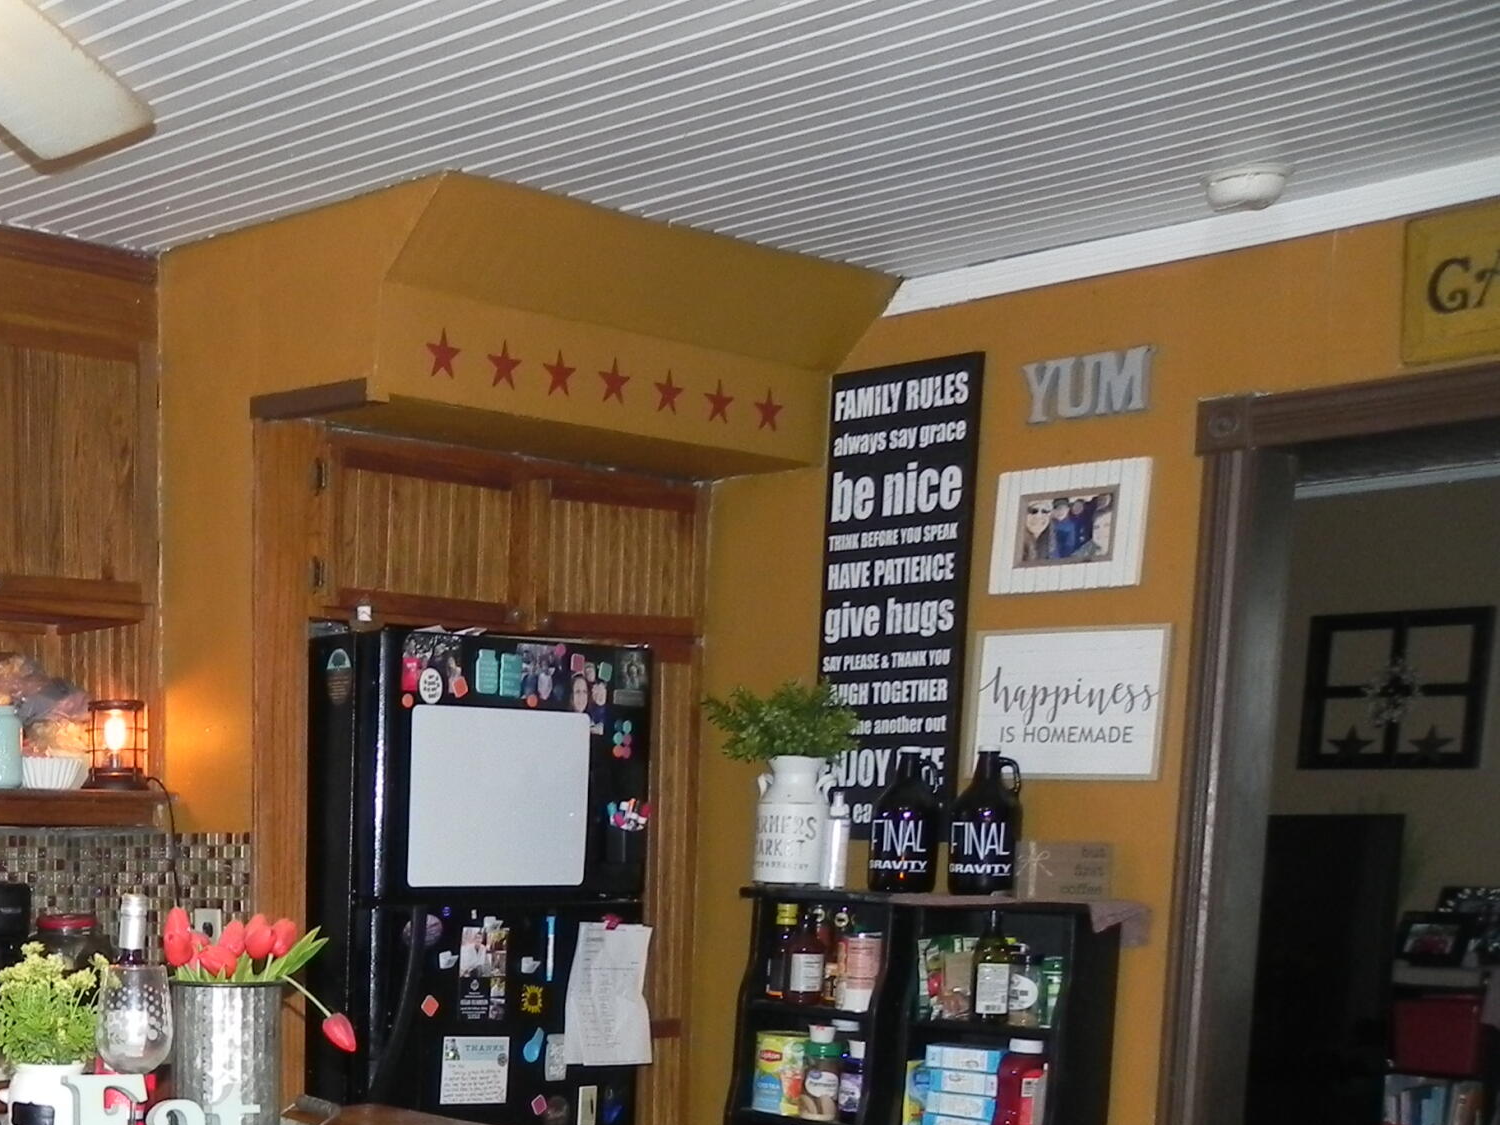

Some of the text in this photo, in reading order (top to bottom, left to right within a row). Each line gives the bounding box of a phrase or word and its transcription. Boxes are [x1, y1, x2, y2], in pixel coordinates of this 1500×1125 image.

[833, 371, 969, 422] FAMILY RULES
[1021, 344, 1150, 424] YUM
[833, 420, 967, 457] always say grace
[830, 461, 963, 523] be nice
[828, 521, 959, 552] THINK BEFORE YOU SPEAK
[827, 552, 955, 591] HAVE PATIENCE
[824, 597, 955, 644] give hugs
[822, 648, 951, 673] SAY PLEASE & THANK YOU
[826, 678, 948, 707] AUGH TOGETHER
[979, 666, 1160, 725] happiness
[874, 715, 924, 735] another
[925, 715, 947, 733] out
[1000, 725, 1134, 744] IS HOMEMADE
[829, 748, 892, 787] NJOY
[871, 820, 926, 856] FINAL
[950, 822, 1010, 860] FINAL
[869, 860, 928, 871] GRAVITY
[949, 863, 1012, 875] GRAVITY
